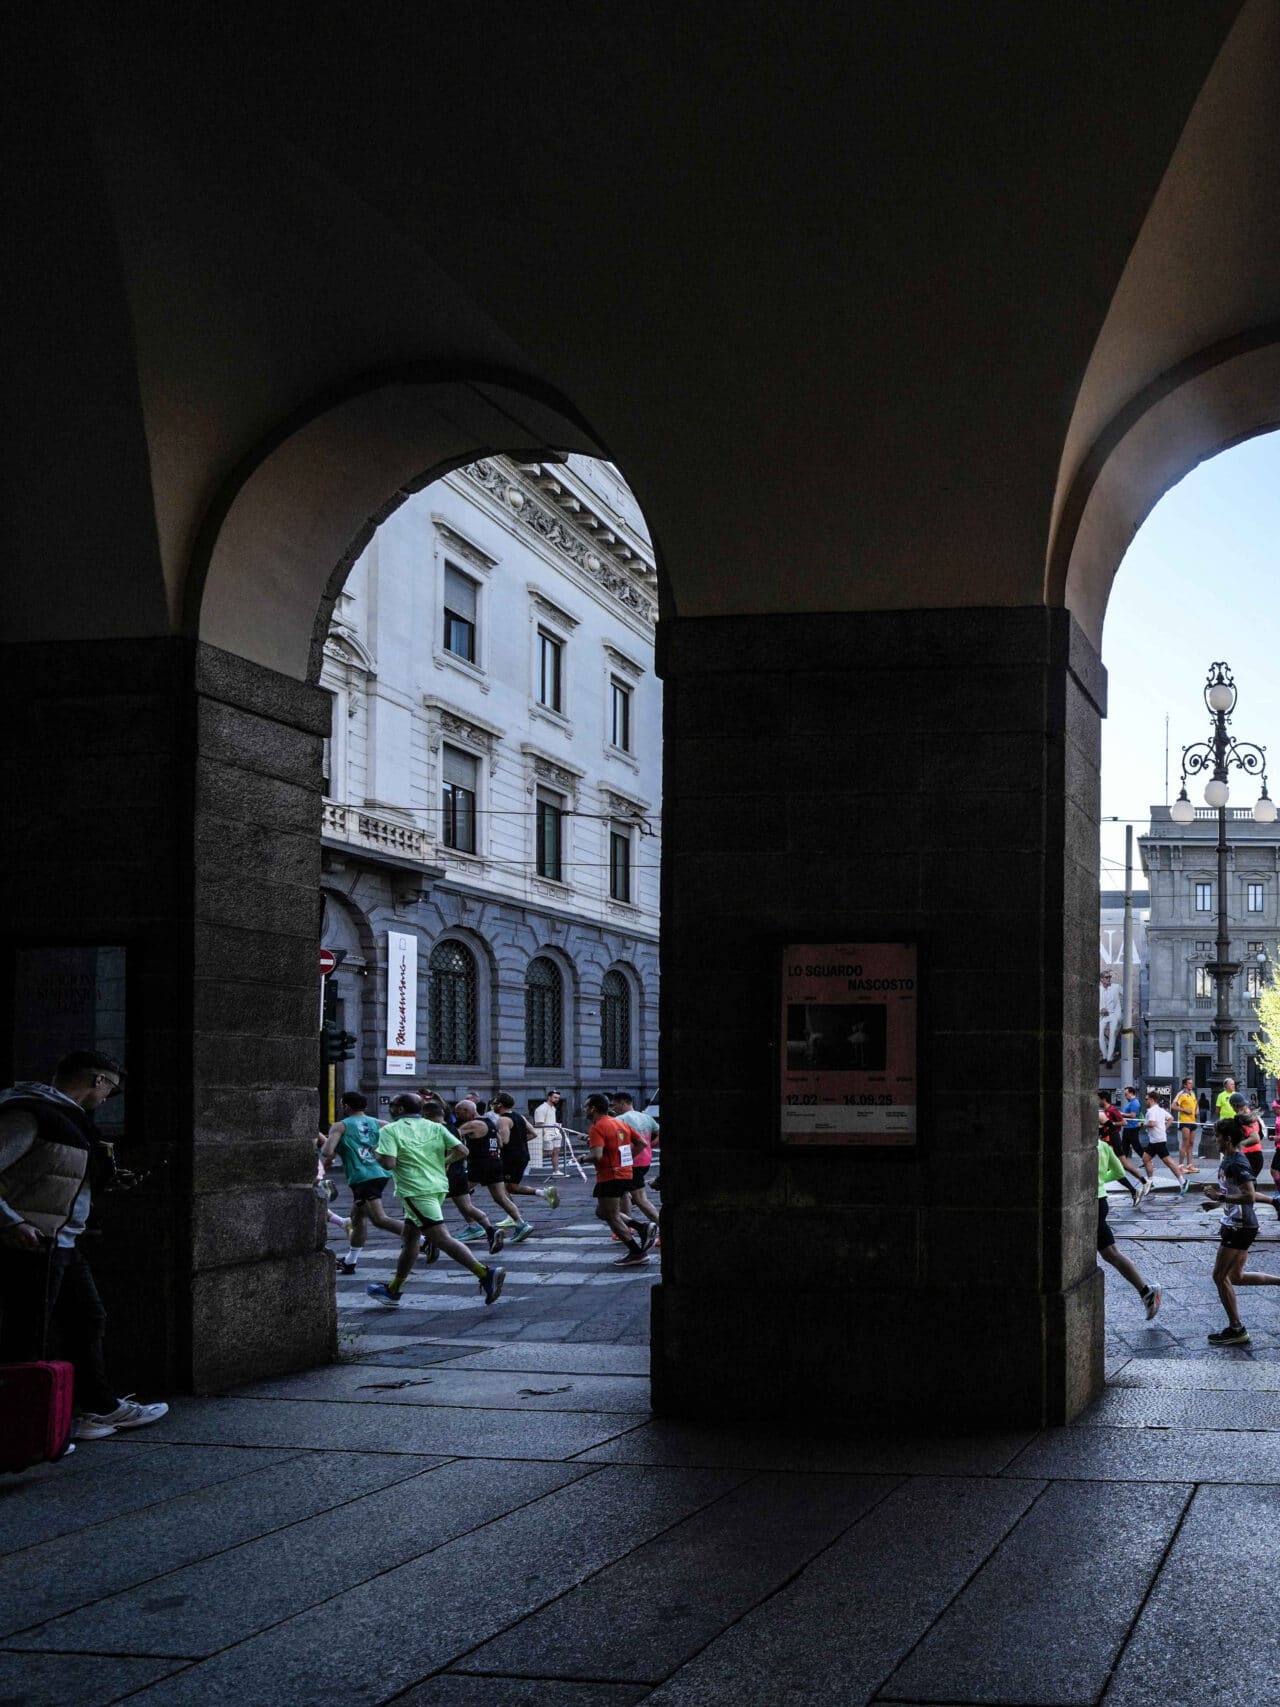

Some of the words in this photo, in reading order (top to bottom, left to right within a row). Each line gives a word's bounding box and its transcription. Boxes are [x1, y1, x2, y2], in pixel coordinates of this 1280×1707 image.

[787, 965, 802, 977] LO
[806, 965, 863, 977] SGUARDO
[847, 979, 914, 991] NASCOSTO
[786, 1094, 817, 1106] 12.02
